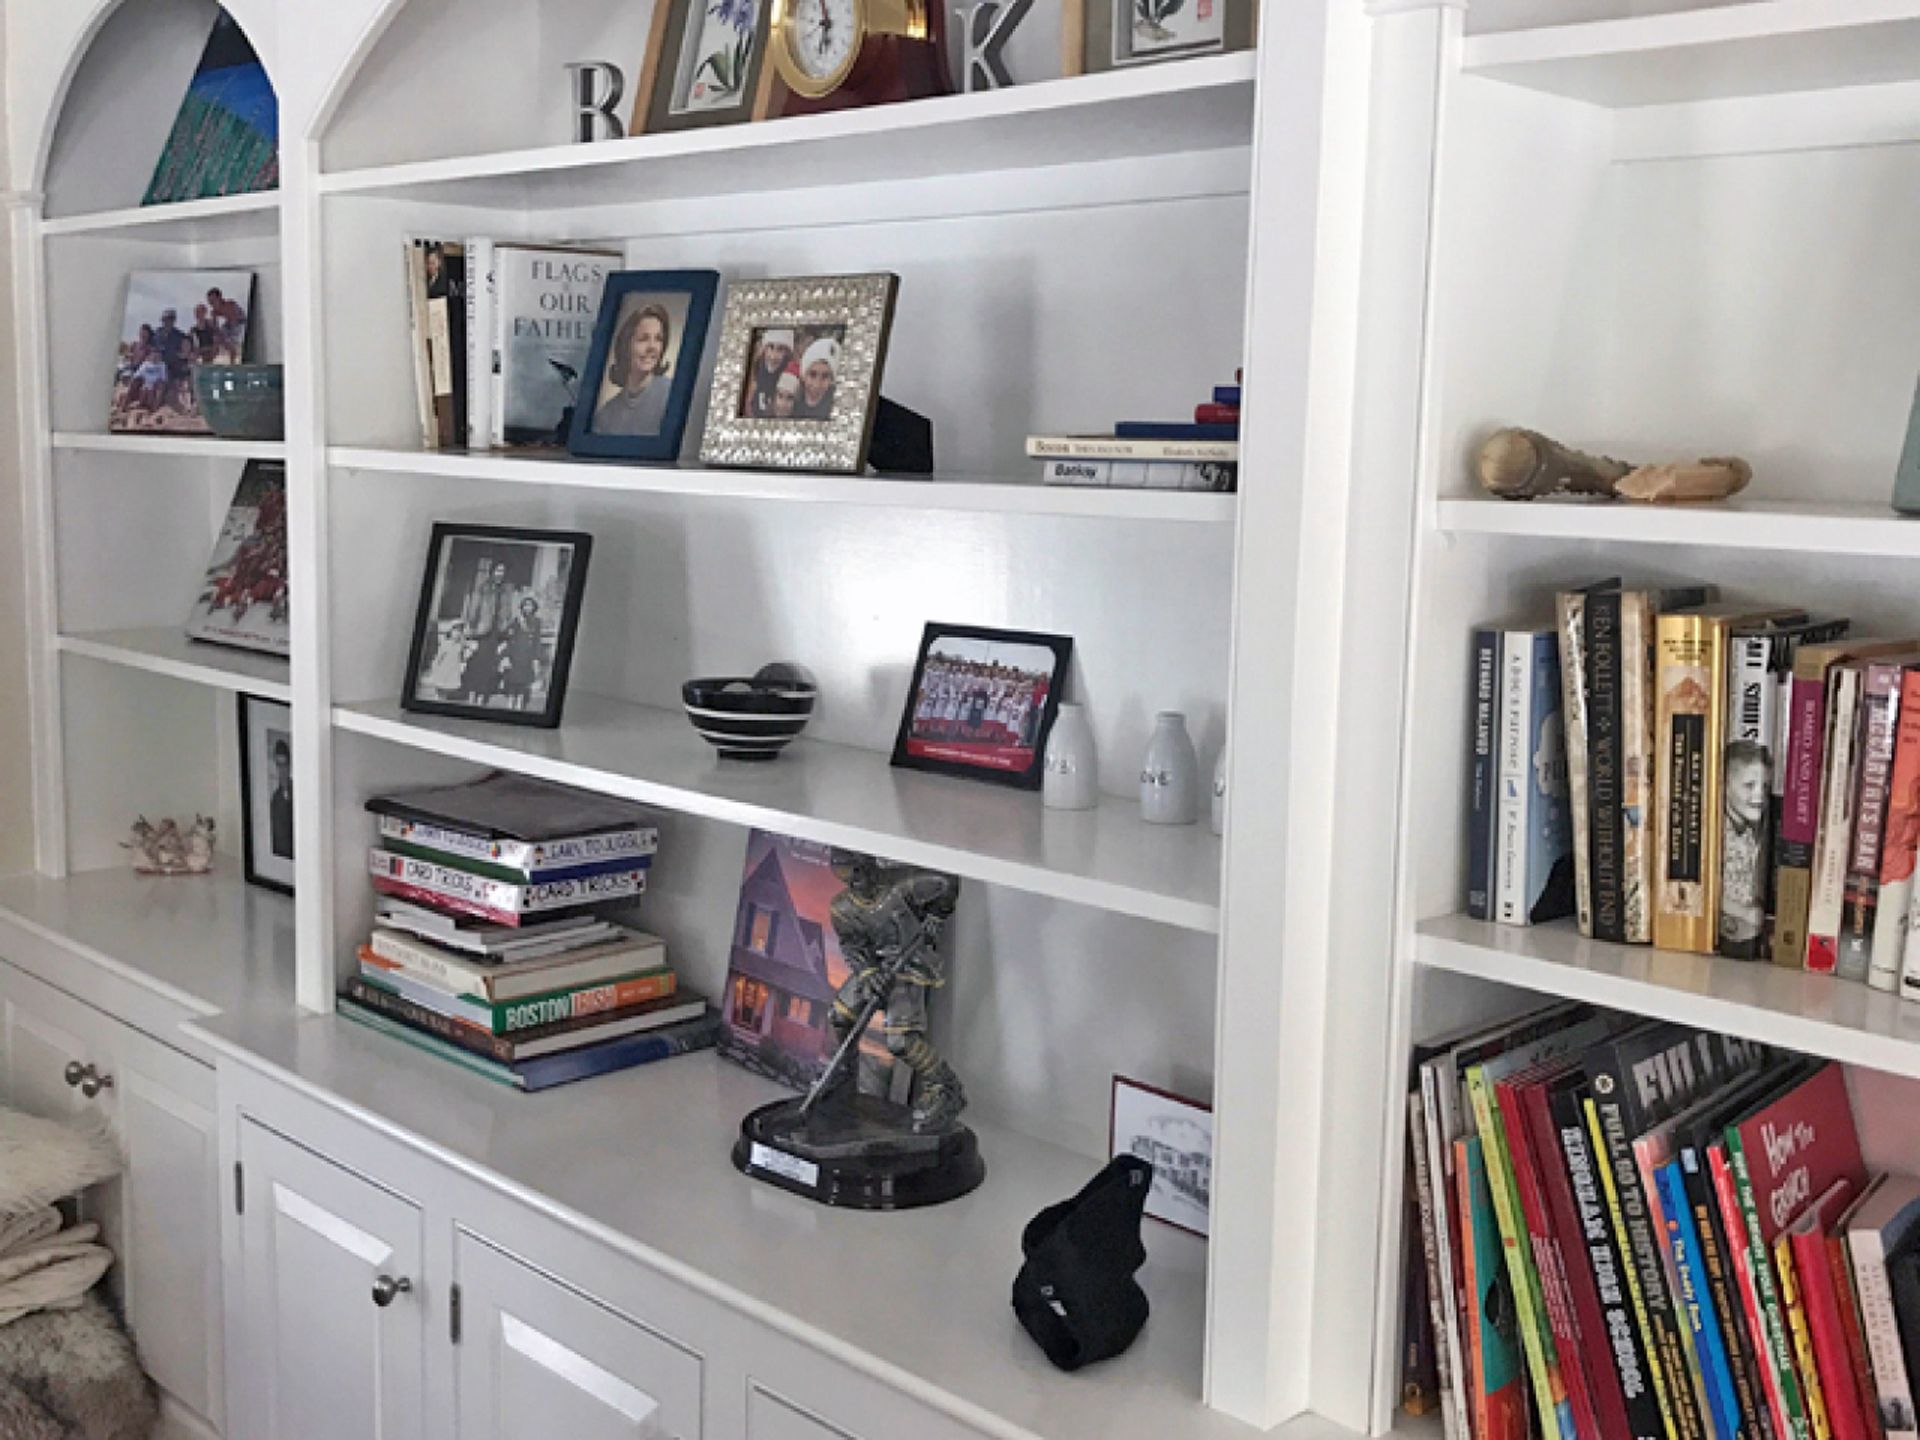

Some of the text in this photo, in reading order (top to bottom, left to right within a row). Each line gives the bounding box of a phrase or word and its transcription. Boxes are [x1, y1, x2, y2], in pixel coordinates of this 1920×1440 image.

[955, 0, 1034, 95] K
[563, 62, 627, 144] R
[531, 261, 603, 282] FLAGS
[514, 317, 593, 340] FATHE
[540, 293, 592, 313] OUR
[1055, 463, 1097, 480] Banksy
[1479, 648, 1491, 699] BERNARD
[1475, 702, 1489, 755] MALAMUD
[1742, 682, 1761, 740] SOULS
[1509, 709, 1520, 768] PURPOSE
[1796, 699, 1816, 825] ROMEO AND JULIET
[1593, 604, 1617, 927] KEN FOLLETT WORLD WITHOUT END
[1857, 831, 1878, 869] BAR
[506, 994, 570, 1031] BOSTON
[1600, 1103, 1628, 1159] FULL
[1622, 1186, 1643, 1216] TO
[1629, 1218, 1668, 1310] HISTORY
[1674, 1237, 1685, 1261] The
[1590, 1245, 1622, 1304] HIGH
[1606, 1308, 1645, 1399] SCHOOL
